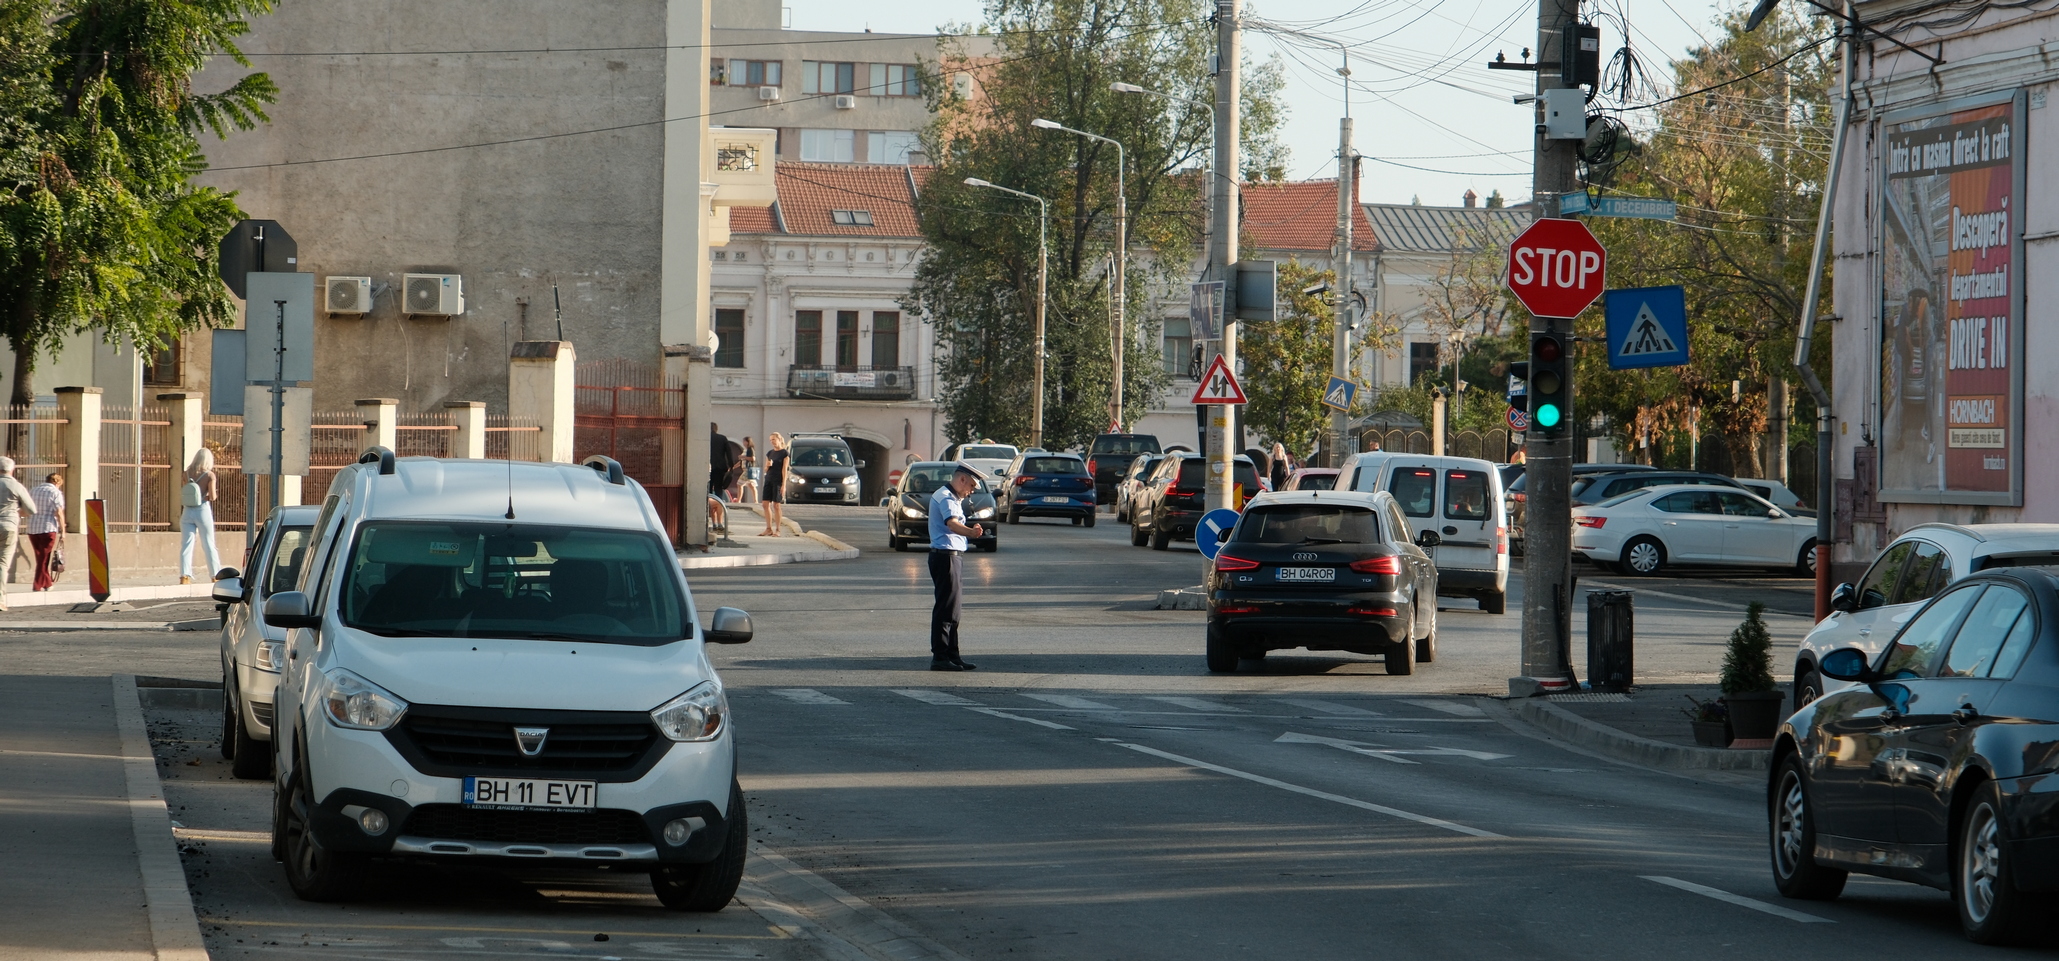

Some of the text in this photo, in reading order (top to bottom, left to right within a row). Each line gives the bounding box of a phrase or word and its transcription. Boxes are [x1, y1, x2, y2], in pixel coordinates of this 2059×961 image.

[1890, 123, 2009, 180] Intră cu mașina direct la raft
[1606, 201, 1611, 213] 1
[1614, 201, 1673, 216] DECEMBRIE
[1952, 196, 2008, 259] Descoperă
[1513, 246, 1600, 290] STOP
[1951, 263, 2007, 308] departamentul
[1949, 316, 2007, 370] DRIVE IN
[1950, 398, 1995, 424] HORNBACH
[1281, 568, 1297, 579] BH
[464, 791, 474, 801] RO
[476, 780, 593, 805] BH 11 EVT
